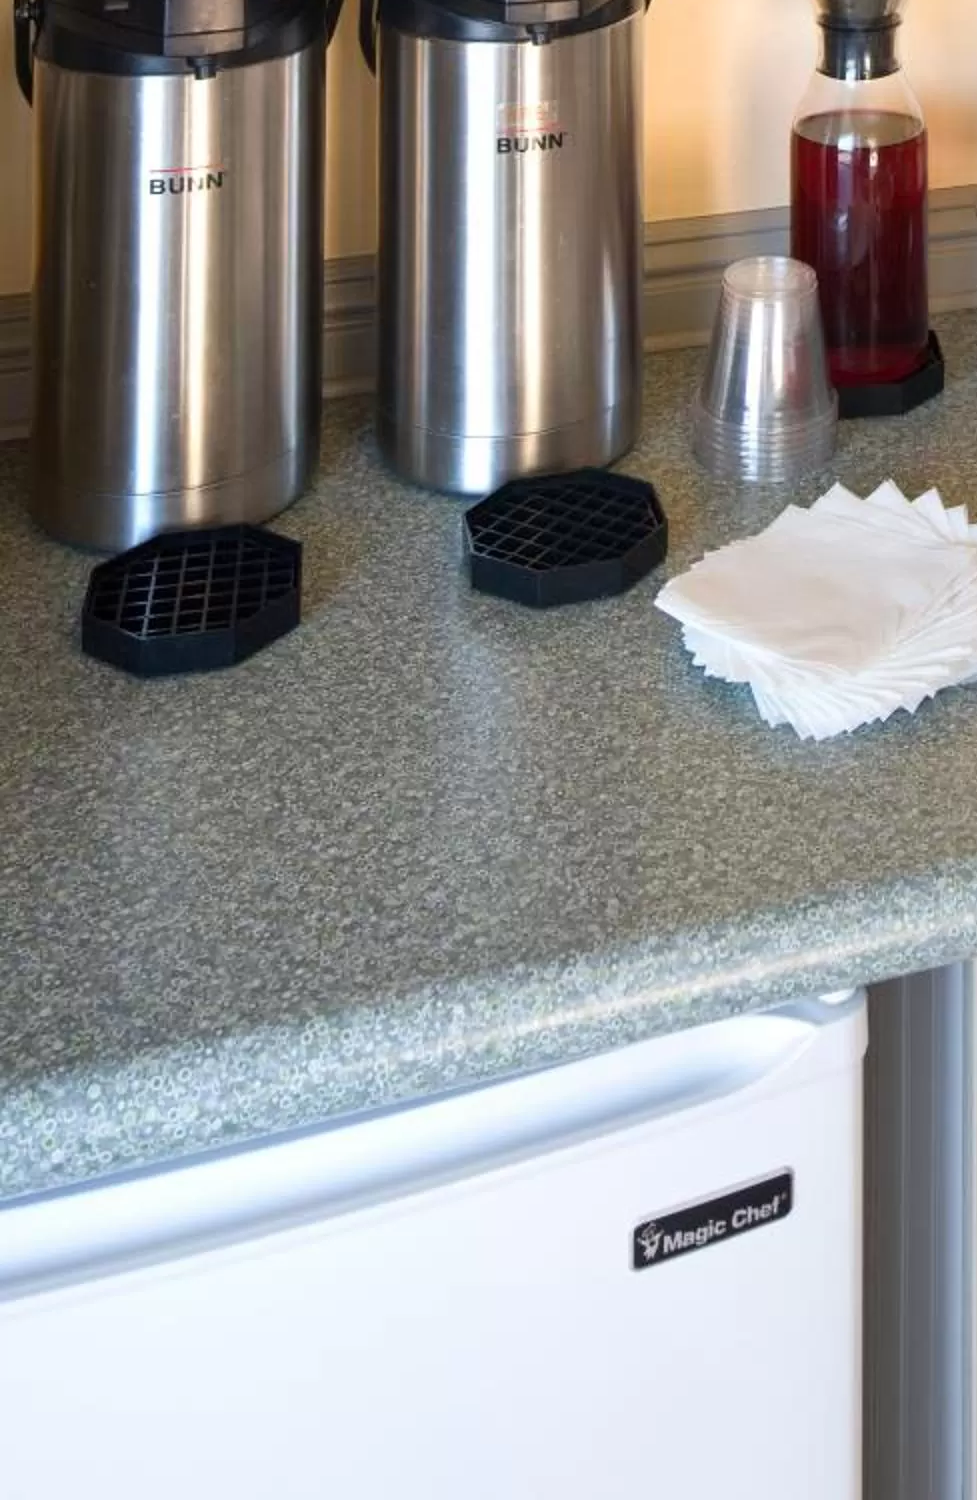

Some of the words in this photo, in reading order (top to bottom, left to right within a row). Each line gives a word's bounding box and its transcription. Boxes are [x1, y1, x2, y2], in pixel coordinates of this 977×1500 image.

[496, 132, 564, 153] BUNN
[149, 171, 224, 195] BUNN
[663, 1220, 727, 1255] Magic
[731, 1195, 780, 1228] Chef
